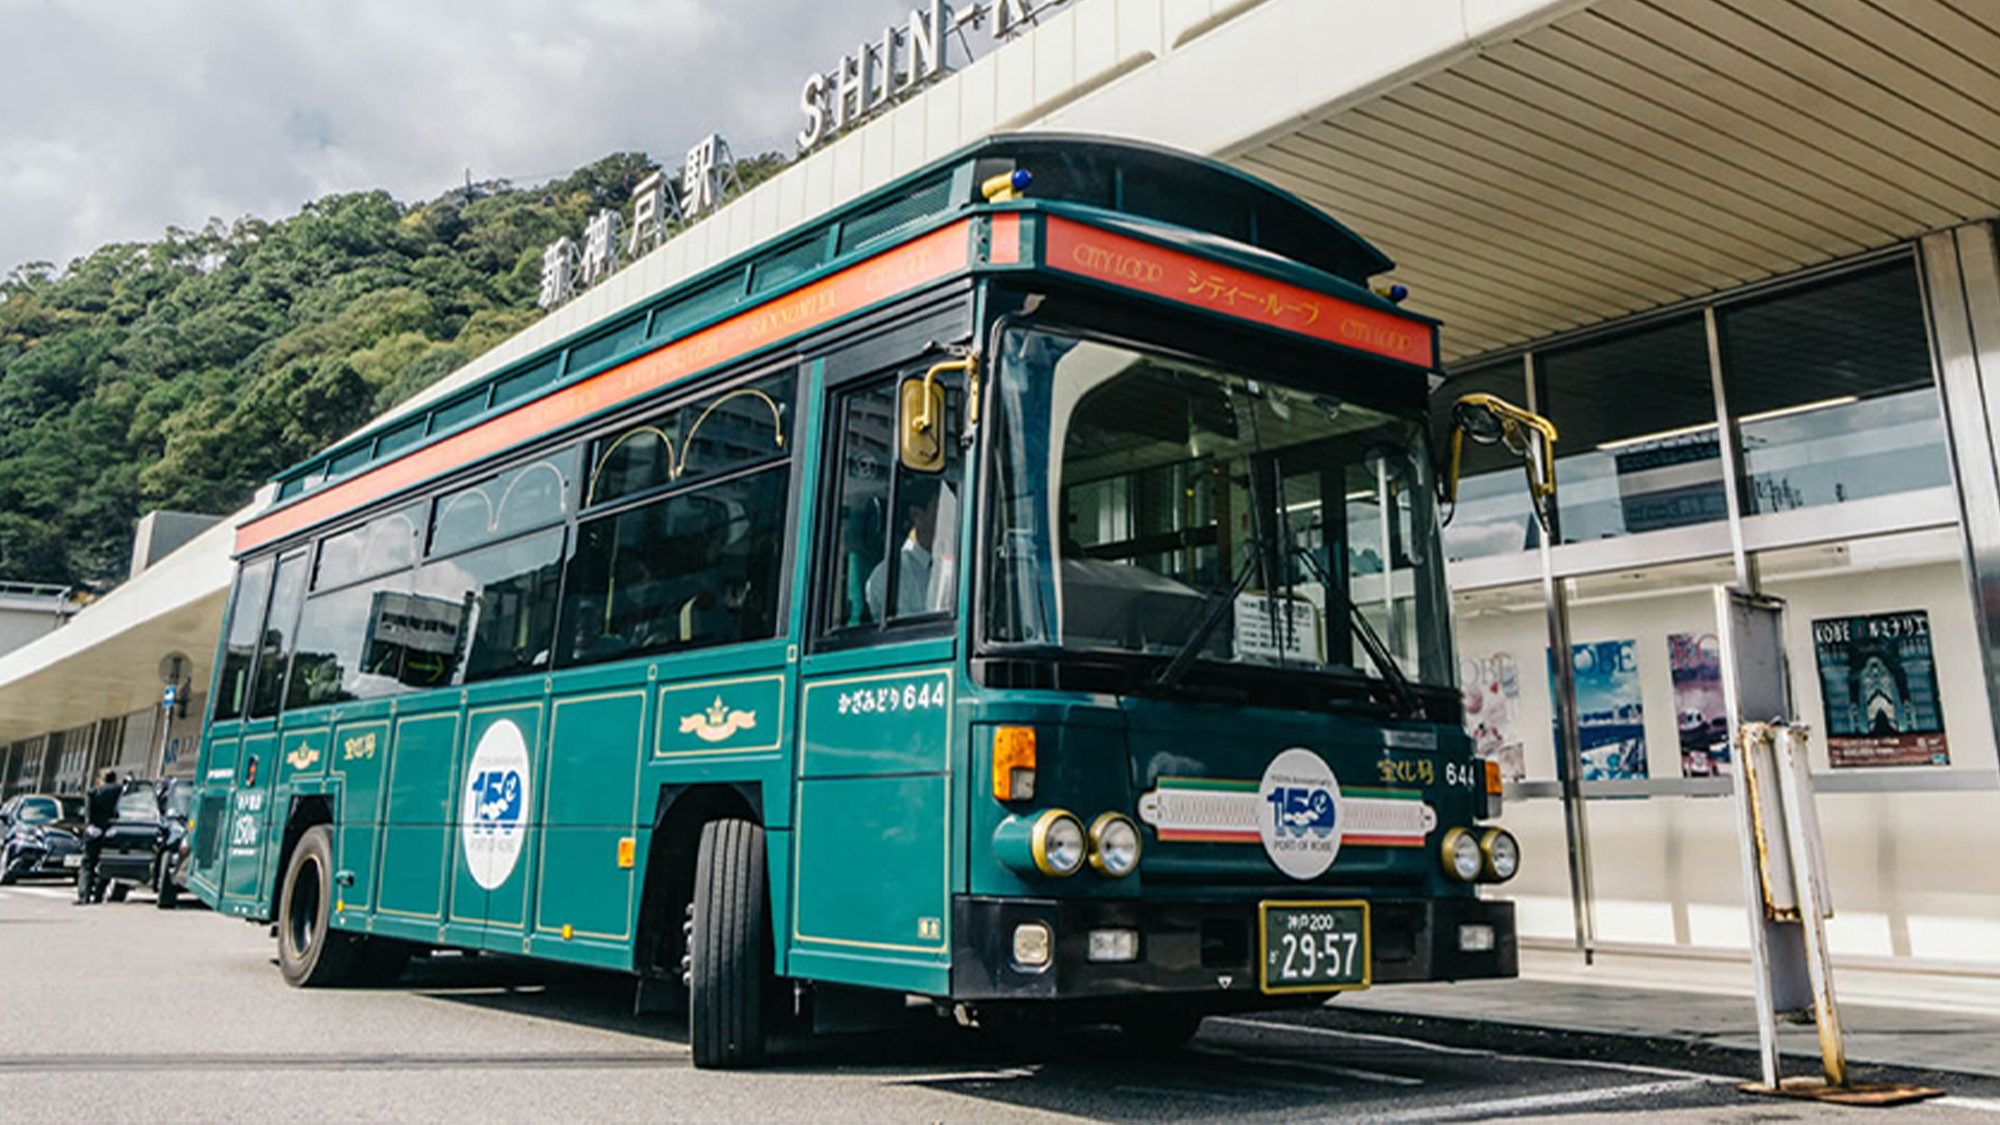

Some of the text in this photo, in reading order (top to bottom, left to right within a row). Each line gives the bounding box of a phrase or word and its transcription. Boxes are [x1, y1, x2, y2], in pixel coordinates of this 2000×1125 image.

[537, 134, 717, 308] 新神戸駅
[1073, 243, 1112, 272] CITY
[1186, 269, 1320, 324] シティー・ループ
[1814, 620, 1850, 644] KOBE
[1572, 644, 1637, 676] OBE
[1671, 634, 1720, 670] KO
[903, 681, 945, 711] 644
